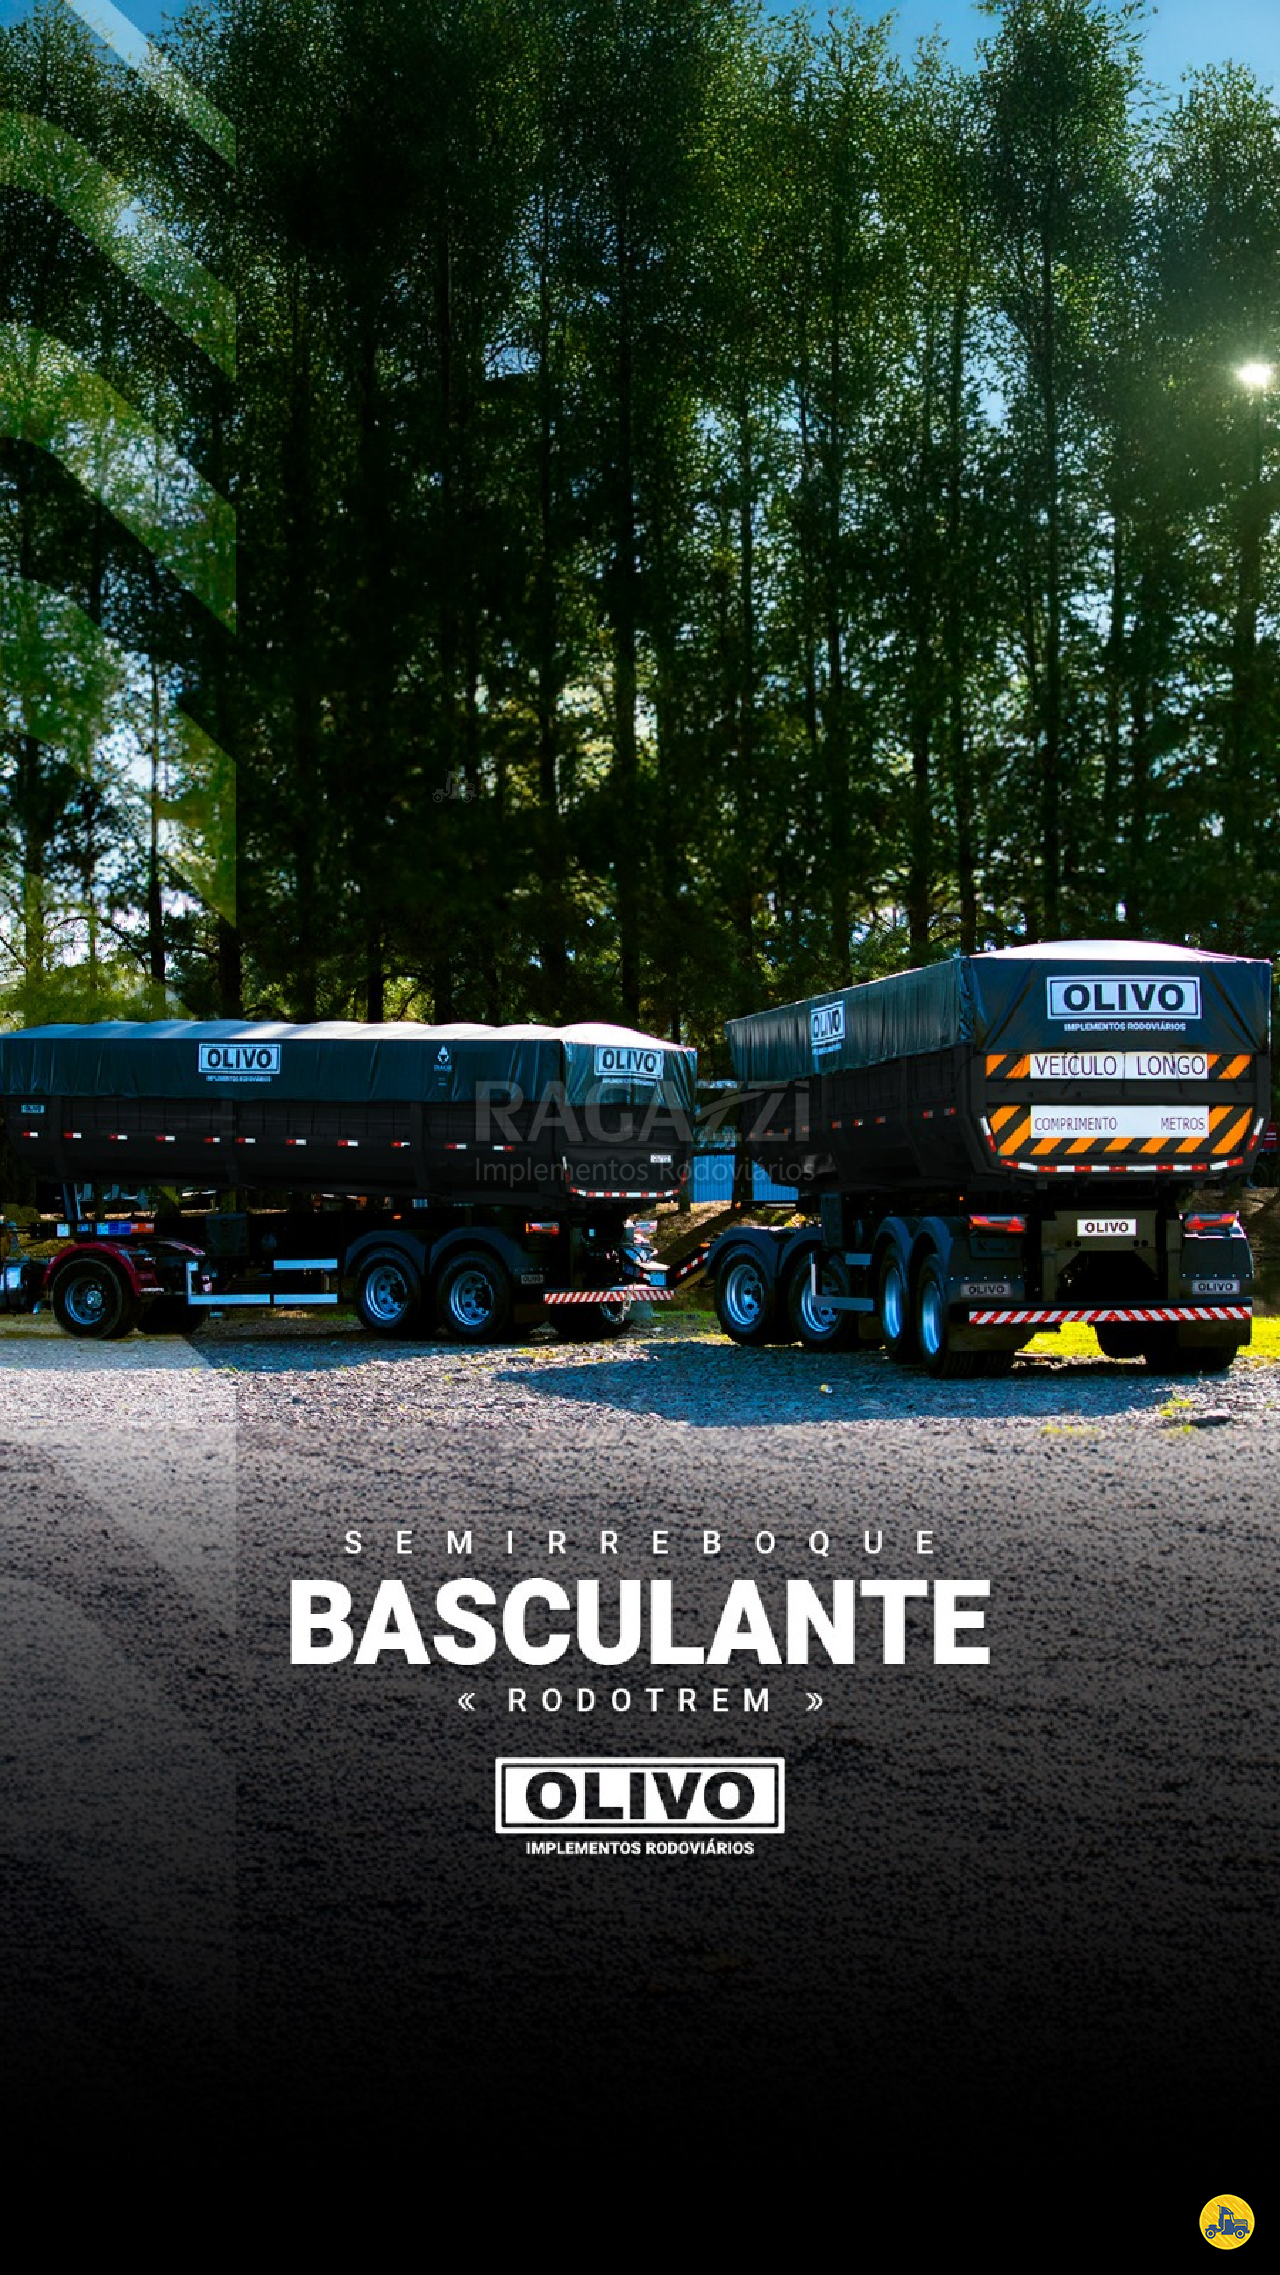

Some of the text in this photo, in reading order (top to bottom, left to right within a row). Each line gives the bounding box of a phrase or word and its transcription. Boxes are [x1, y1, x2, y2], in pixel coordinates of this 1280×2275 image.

[1063, 983, 1185, 1012] OLIVO
[207, 1048, 273, 1069] OLIVO
[602, 1048, 656, 1073] OLIVO
[1136, 1055, 1206, 1076] LONGO
[1034, 1117, 1206, 1131] COMPRIMENTO METROS
[1084, 1222, 1130, 1234] OLIVO
[968, 1284, 1005, 1295] OLIVO
[1197, 1282, 1234, 1292] OLIVO
